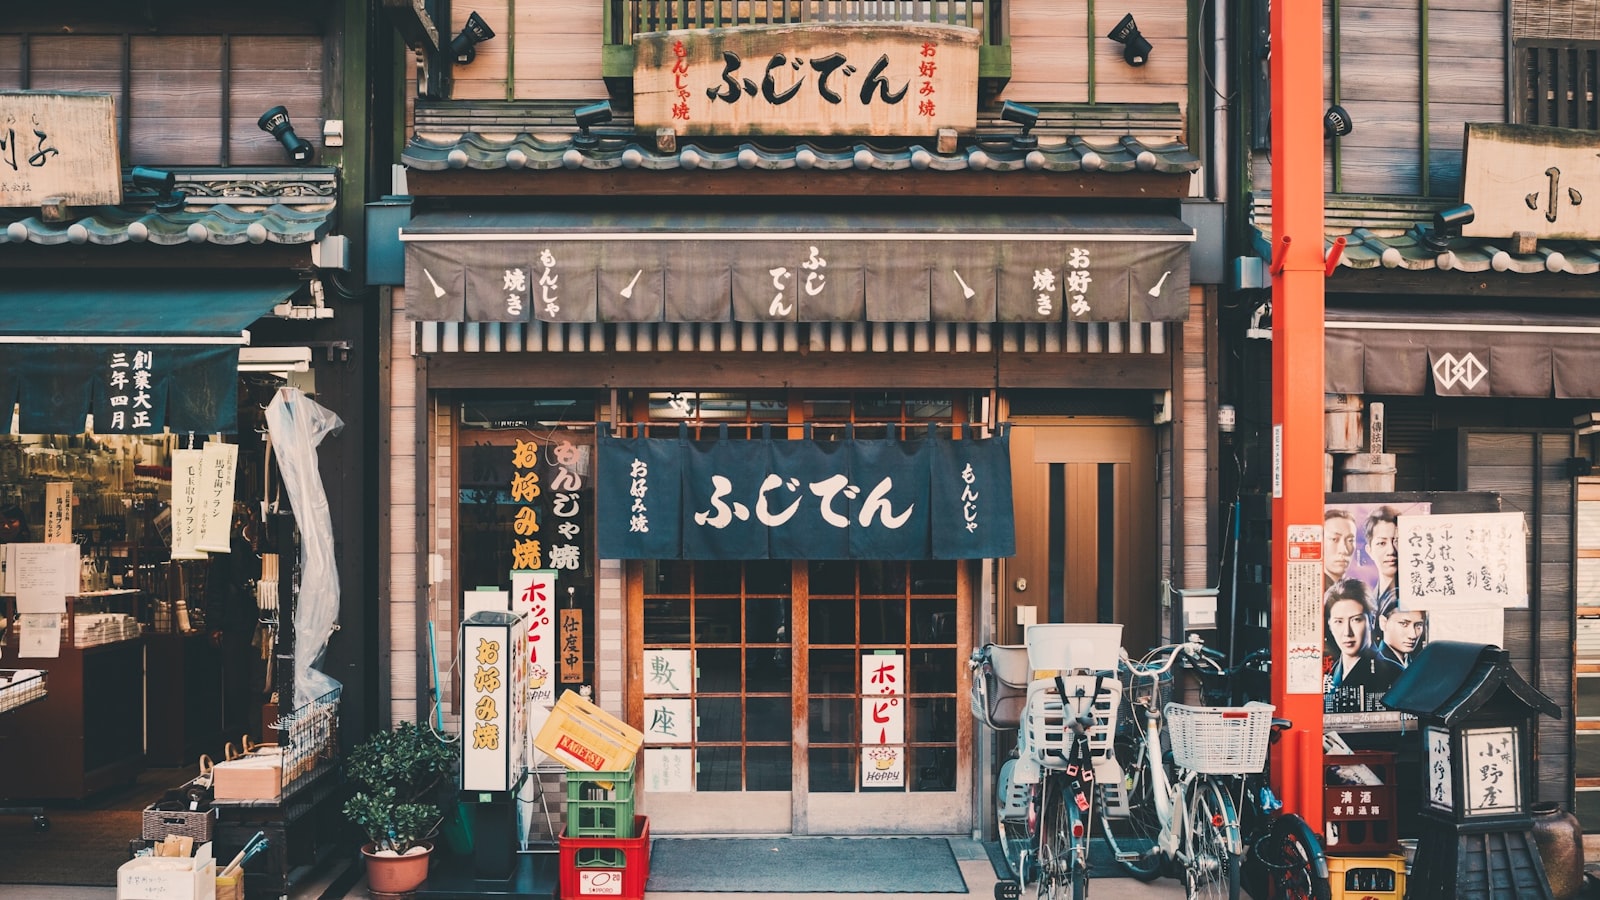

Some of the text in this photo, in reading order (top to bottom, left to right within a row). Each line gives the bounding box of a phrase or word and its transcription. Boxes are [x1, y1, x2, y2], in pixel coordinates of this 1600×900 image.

[672, 40, 690, 121] もんじゃ焼
[706, 51, 910, 105] ふじでん
[918, 42, 937, 117] お好み焼
[1525, 166, 1583, 223] 小
[503, 268, 526, 316] 焼き
[538, 249, 560, 318] もんじゃ
[1033, 269, 1056, 316] 焼き
[1067, 247, 1092, 316] お好み
[110, 352, 129, 430] 三年四月
[133, 350, 153, 429] 創業大正
[511, 438, 542, 570] お好み焼
[549, 440, 582, 570] もんじゃ焼
[629, 458, 649, 533] お好み焼
[694, 473, 914, 529] ふじでん
[961, 462, 979, 534] もんじゃ
[521, 578, 549, 663] ホッピー
[563, 615, 580, 671] 仕度中
[472, 637, 500, 750] お好み焼
[871, 659, 898, 745] ホッピー
[1341, 791, 1371, 804] 清酒
[1478, 742, 1504, 808] 小野屋
